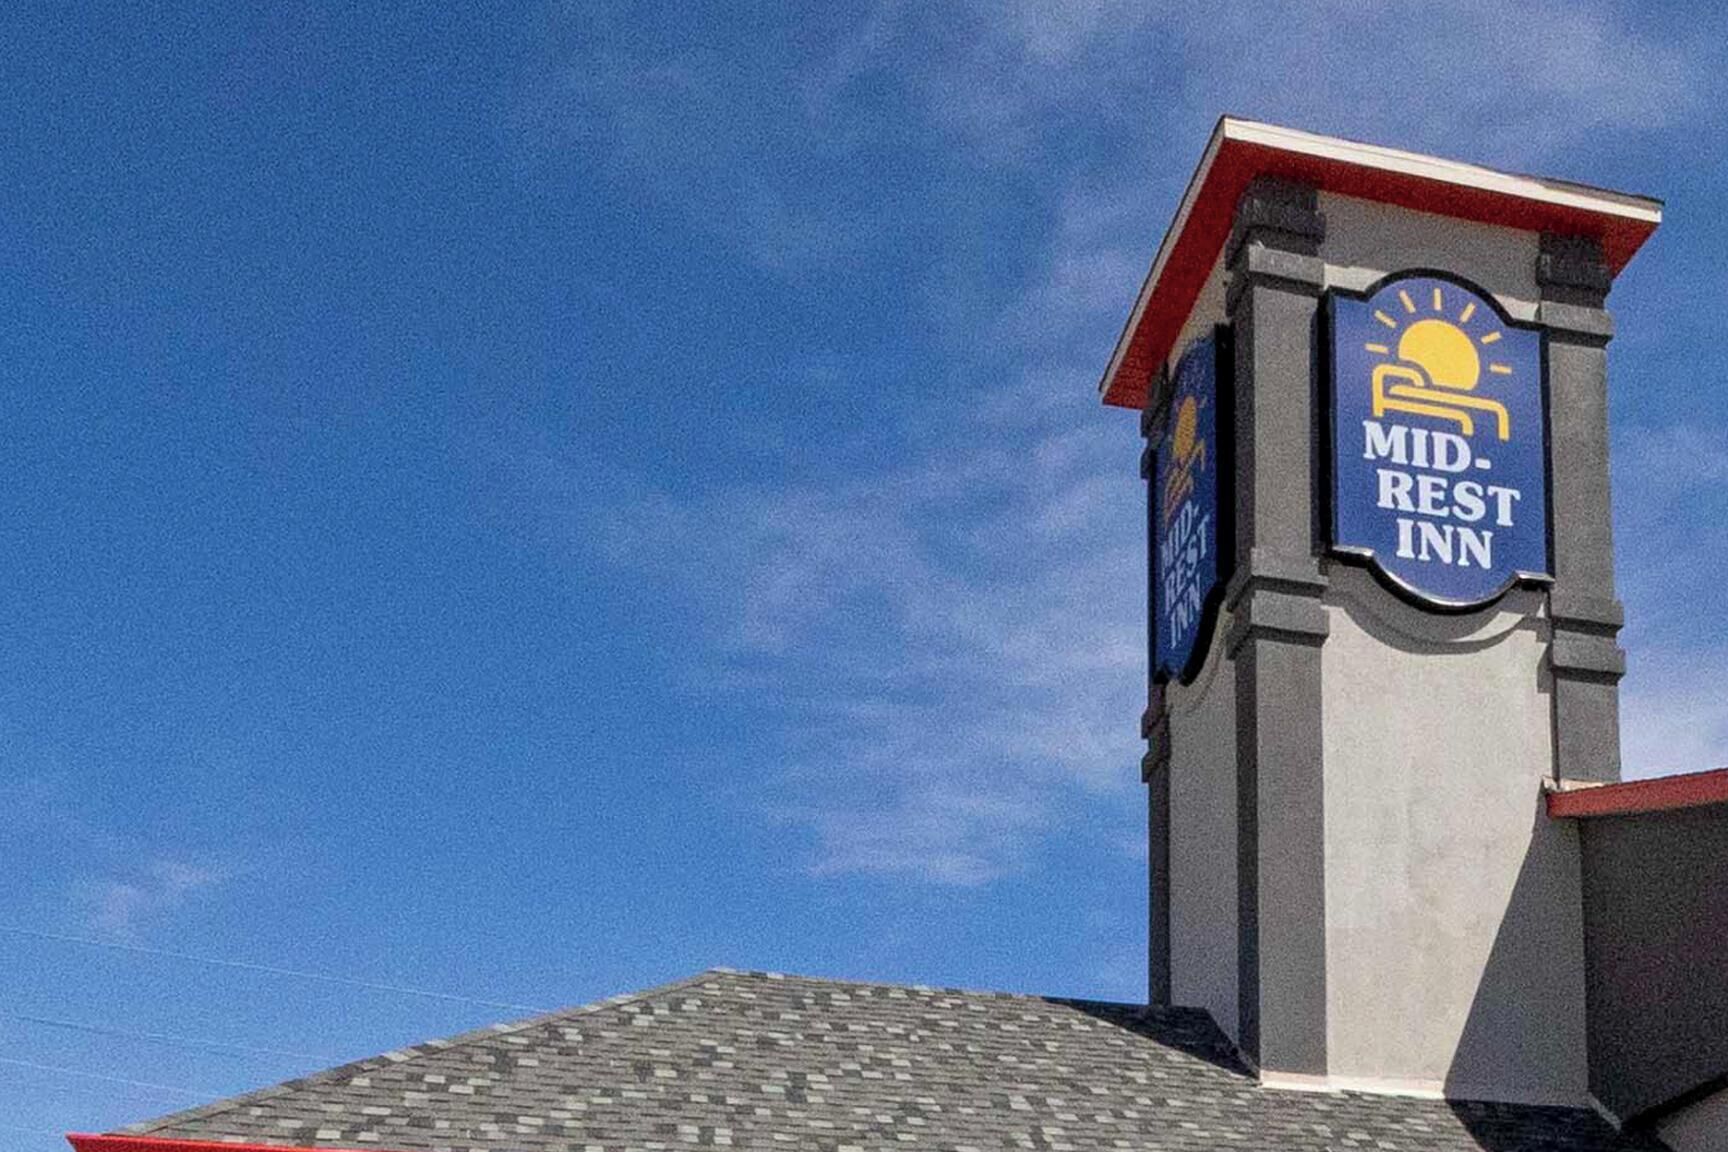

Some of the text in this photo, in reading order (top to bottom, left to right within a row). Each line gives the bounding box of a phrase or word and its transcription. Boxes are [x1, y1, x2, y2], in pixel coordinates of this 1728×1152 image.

[1362, 420, 1491, 473] MID-
[1376, 468, 1521, 527] REST
[1395, 518, 1493, 569] INN
